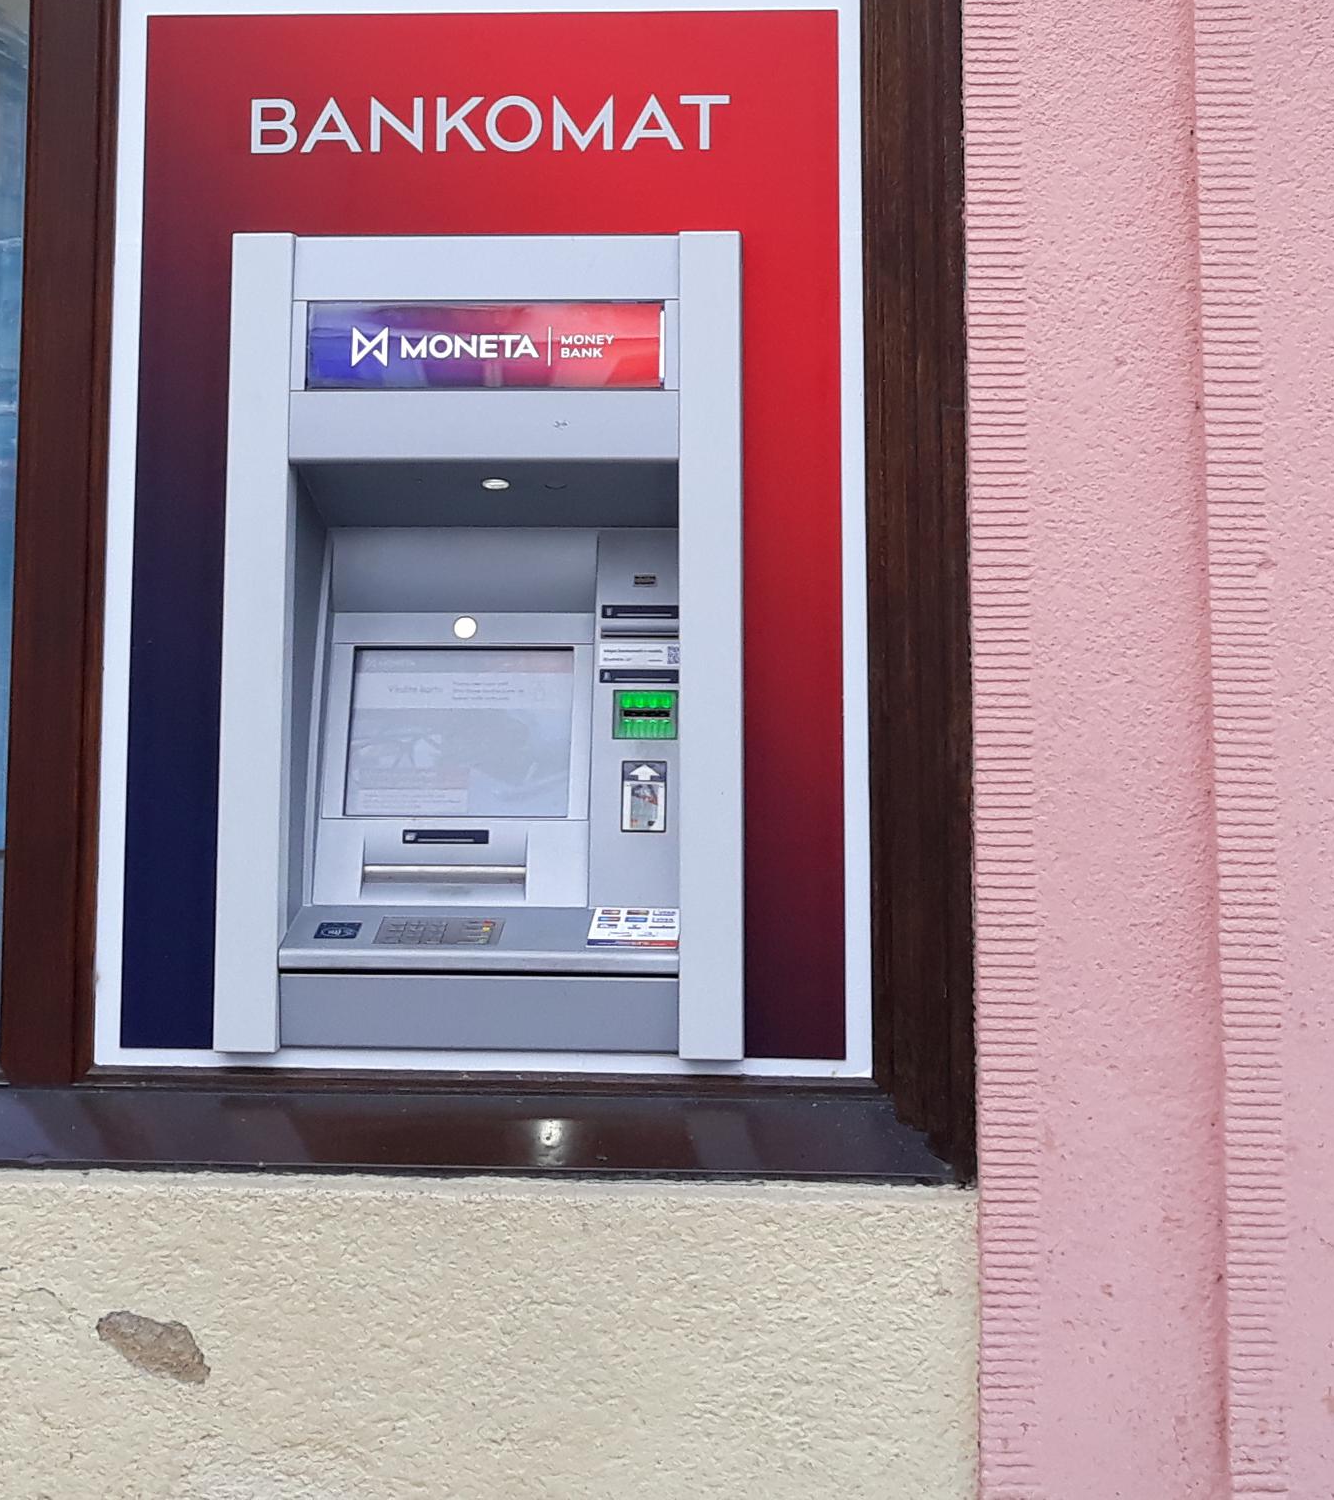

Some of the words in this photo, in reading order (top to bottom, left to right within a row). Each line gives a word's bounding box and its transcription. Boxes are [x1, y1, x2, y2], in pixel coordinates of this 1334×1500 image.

[250, 94, 731, 153] BANKOMAT
[400, 334, 540, 359] MONETA
[560, 334, 615, 346] MONEY
[560, 347, 604, 359] BANK
